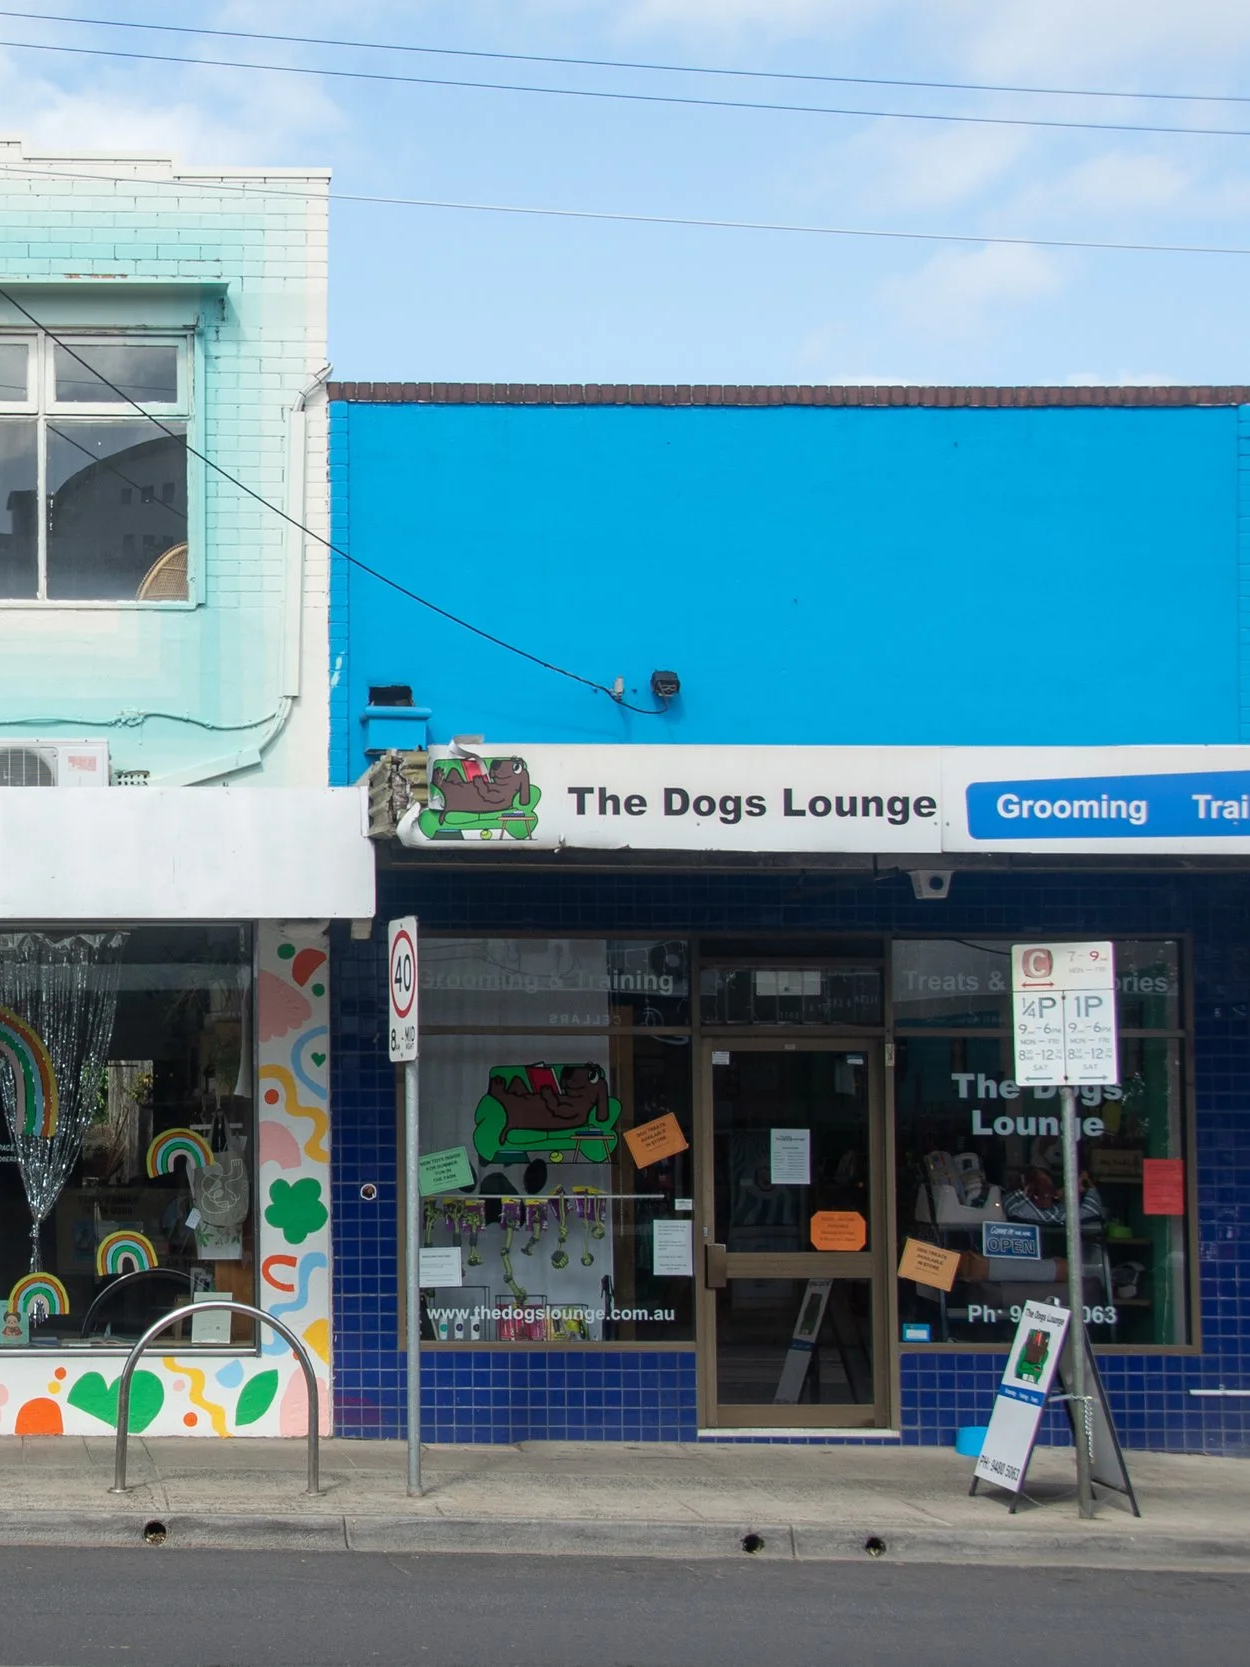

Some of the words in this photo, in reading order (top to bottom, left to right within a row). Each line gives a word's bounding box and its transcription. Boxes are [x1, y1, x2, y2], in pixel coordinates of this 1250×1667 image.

[568, 787, 647, 816] The
[663, 787, 767, 825] Dogs
[783, 788, 937, 826] Lounge
[996, 794, 1148, 826] Grooming
[1191, 794, 1250, 819] Trai
[394, 953, 412, 993] 40
[577, 969, 674, 994] Training
[904, 971, 979, 991] Treats
[988, 971, 1006, 991] &
[1075, 995, 1104, 1018] 1P
[1069, 1037, 1086, 1045] MON
[1032, 1063, 1049, 1071] SAT
[1082, 1063, 1099, 1071] SAT
[951, 1072, 1020, 1099] The
[987, 1236, 1036, 1255] OPEN
[426, 1304, 676, 1323] www.thedogslounge.com.au
[1025, 1307, 1035, 1319] The
[1034, 1310, 1048, 1324] Dogs
